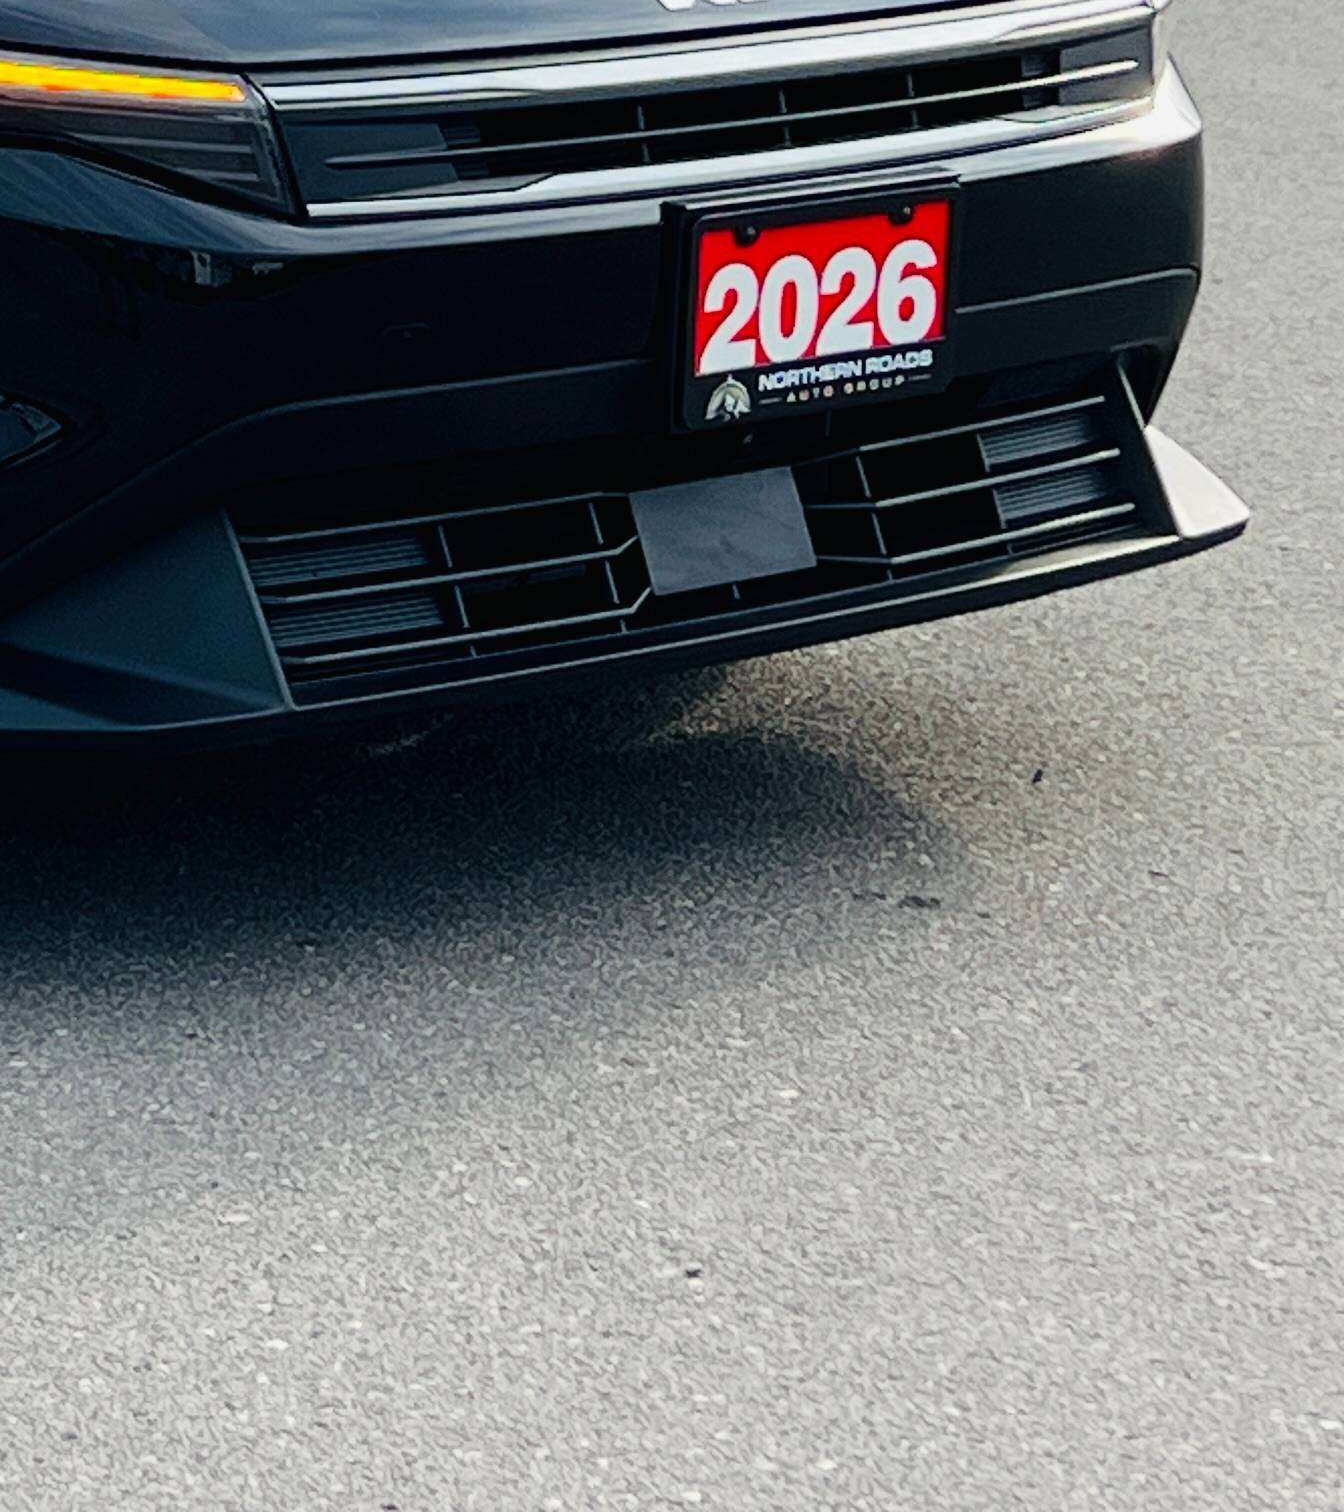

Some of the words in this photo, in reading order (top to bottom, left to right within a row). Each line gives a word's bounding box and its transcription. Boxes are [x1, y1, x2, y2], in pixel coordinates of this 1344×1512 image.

[698, 238, 938, 376] 2026
[758, 359, 863, 391] NORTHERN
[865, 348, 934, 375] ROADS
[786, 385, 834, 402] AUTO
[843, 374, 905, 395] GROUP
